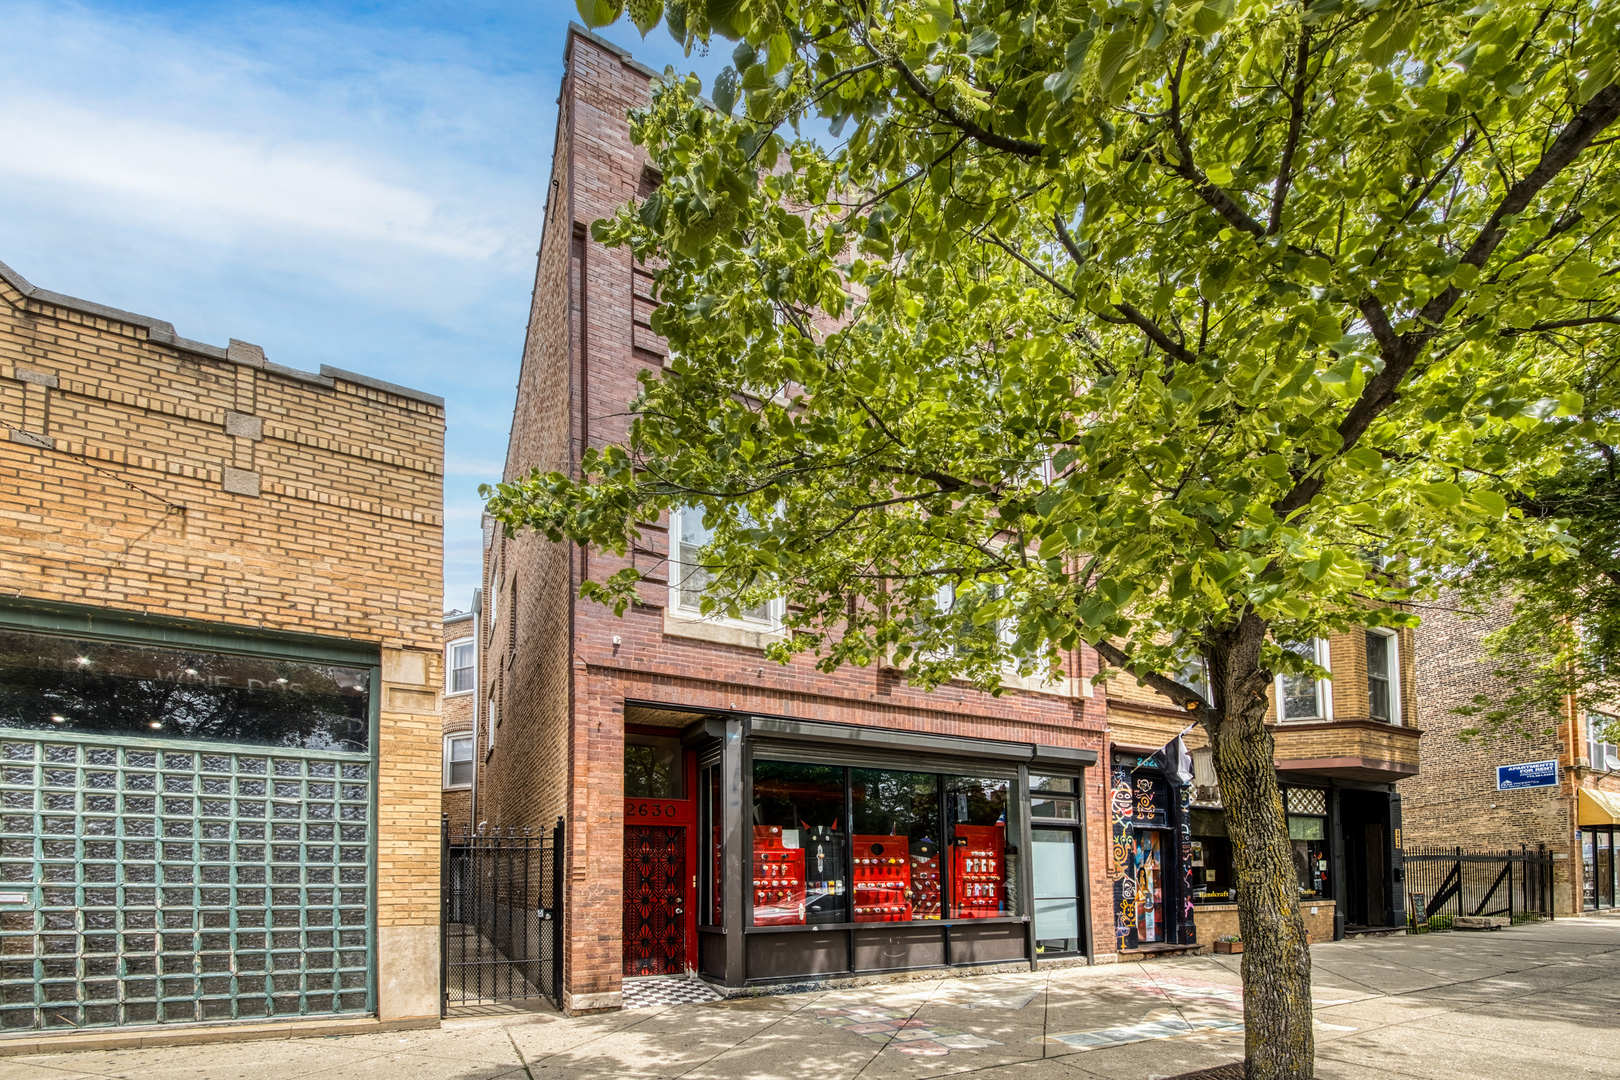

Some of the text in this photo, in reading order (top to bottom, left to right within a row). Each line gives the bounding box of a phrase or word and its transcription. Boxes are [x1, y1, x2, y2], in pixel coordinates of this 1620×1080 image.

[1508, 762, 1554, 771] APARTMENTS
[626, 803, 676, 817] 2630
[1199, 890, 1229, 898] Handcraft
